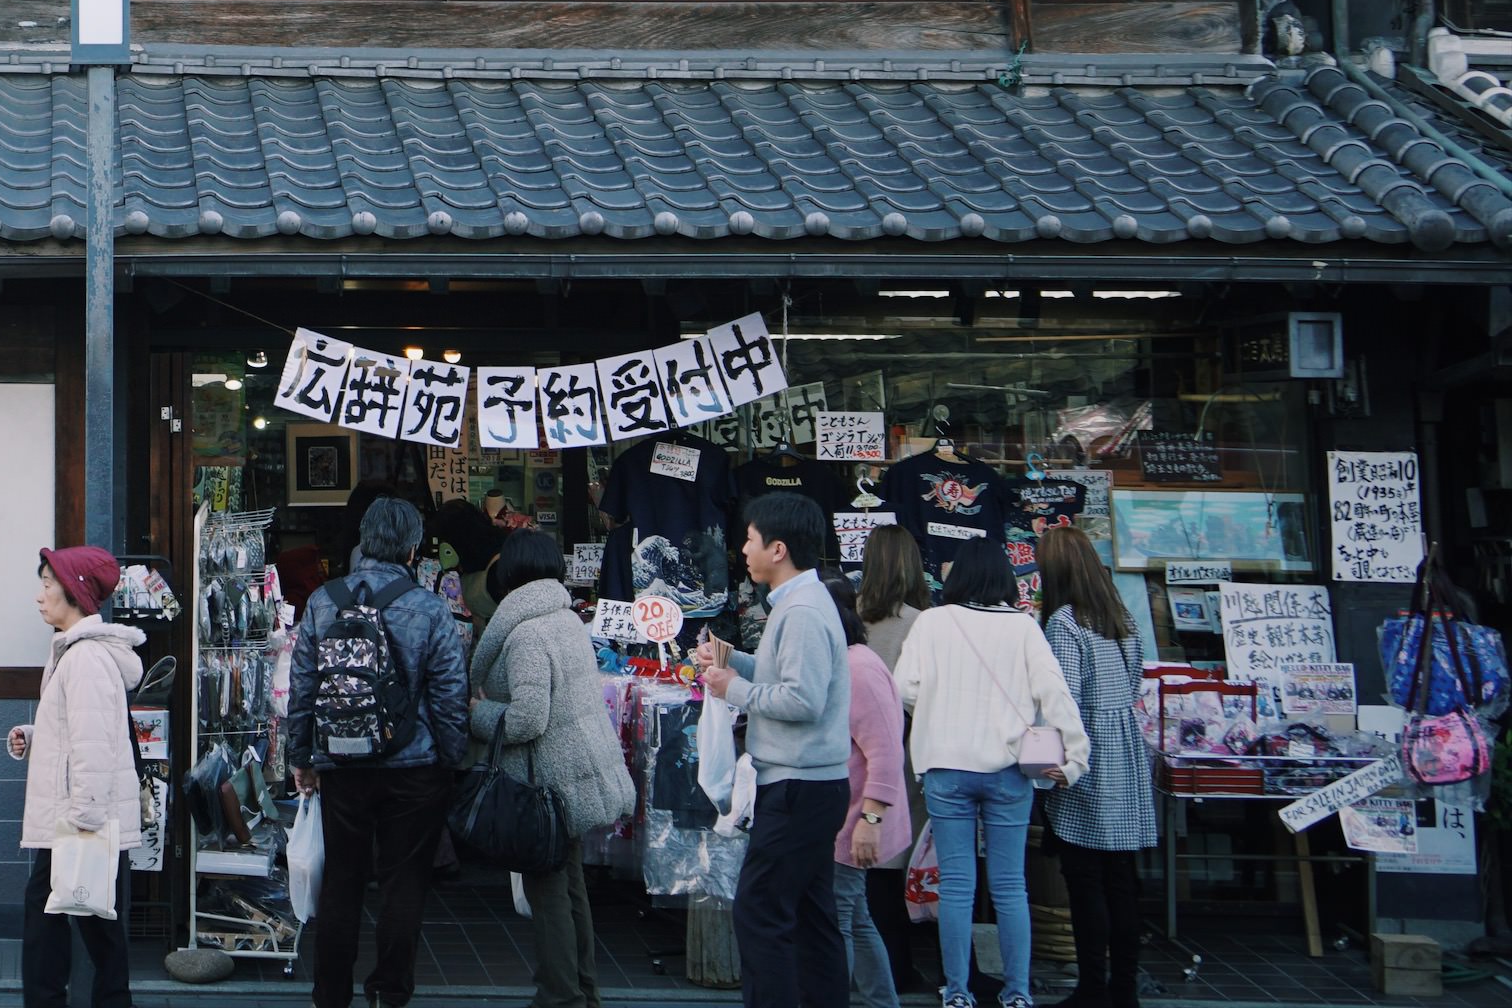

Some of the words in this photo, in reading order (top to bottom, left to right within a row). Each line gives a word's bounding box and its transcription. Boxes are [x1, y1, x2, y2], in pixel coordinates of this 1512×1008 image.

[281, 323, 773, 444] 広辞苑予約受付中
[656, 453, 691, 467] GODZILLA
[765, 477, 802, 486] GODZILLA
[539, 513, 556, 521] VISA
[646, 621, 675, 639] OFF
[1369, 799, 1393, 807] KITTY
